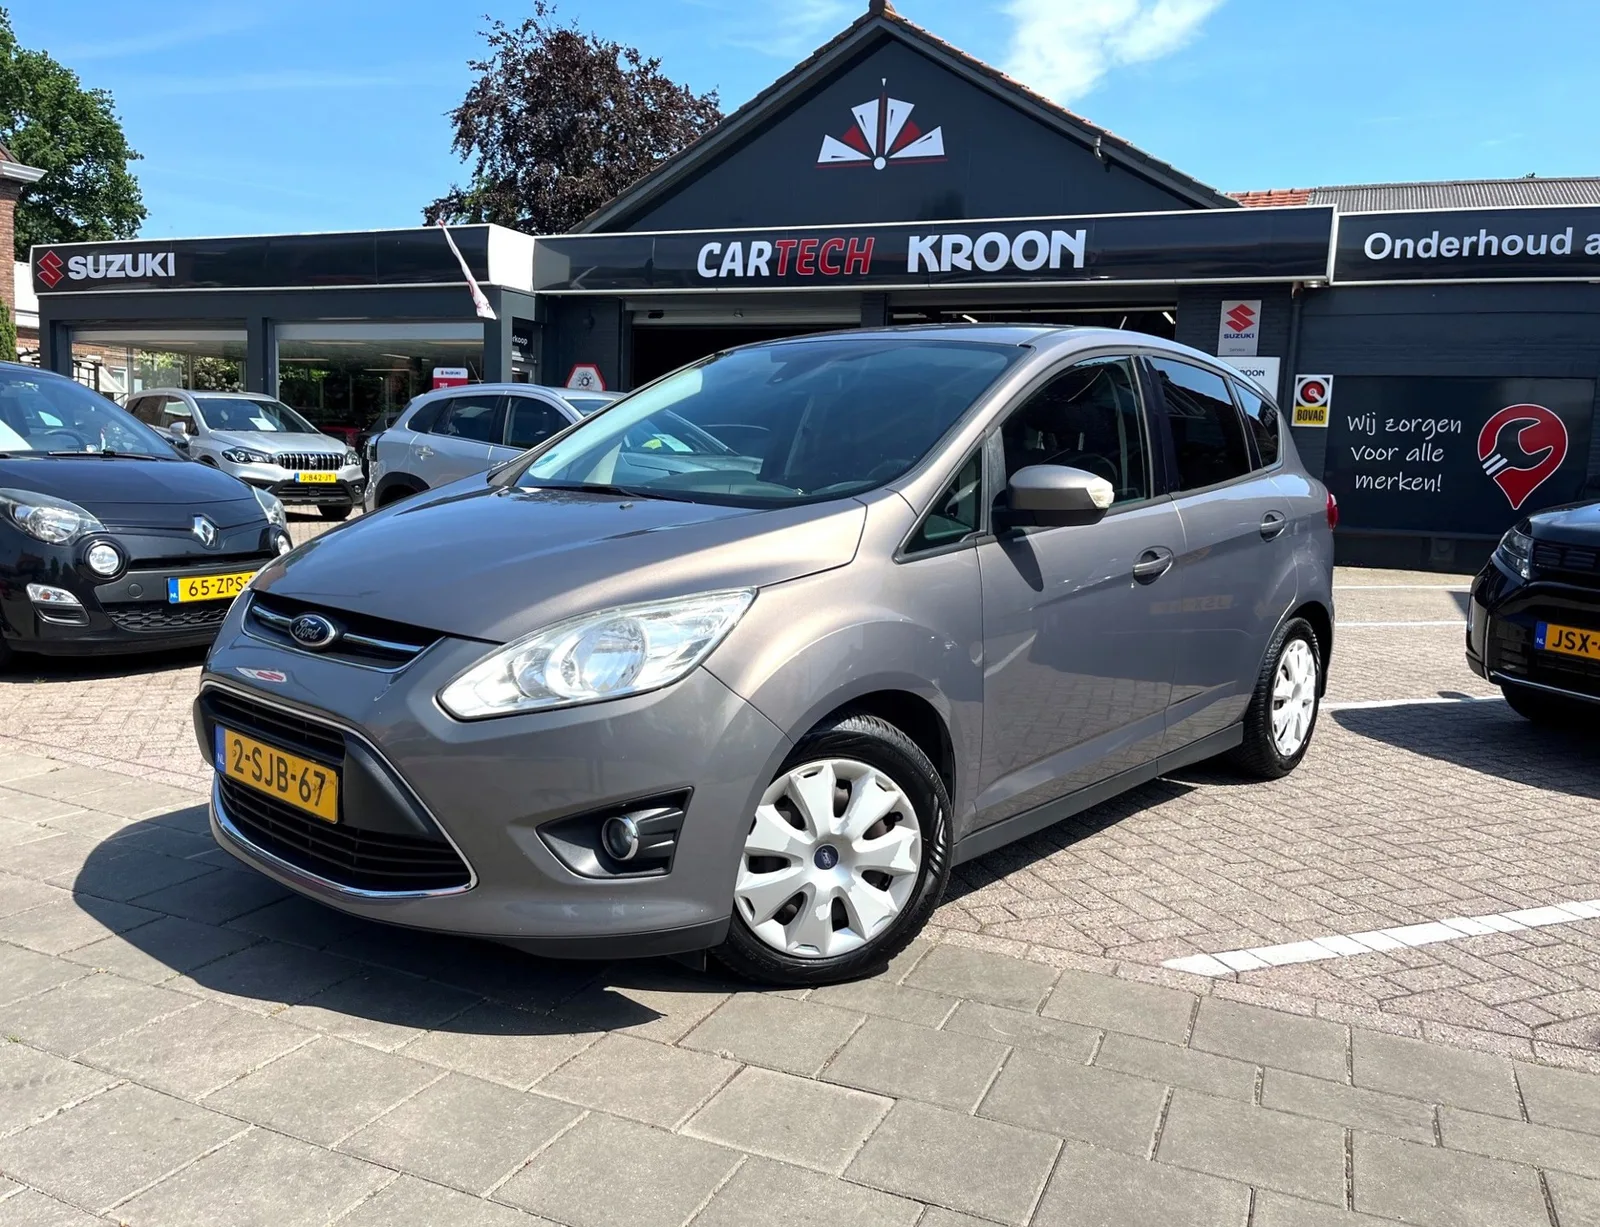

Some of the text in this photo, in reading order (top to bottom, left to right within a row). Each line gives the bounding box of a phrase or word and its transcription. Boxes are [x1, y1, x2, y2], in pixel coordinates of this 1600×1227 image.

[697, 229, 1087, 278] CARTECH KROON
[1364, 226, 1574, 260] Onderhoud
[67, 252, 176, 280] SUZUKI
[1296, 409, 1324, 421] BOVAG
[1347, 411, 1461, 440] Wij zorgen
[1350, 442, 1444, 462] voor alle
[1355, 471, 1442, 492] merken!
[188, 575, 253, 597] 65-ZPS-
[294, 617, 322, 640] Ford
[1552, 629, 1600, 653] JSX-
[233, 738, 327, 807] 2-SJB-67
